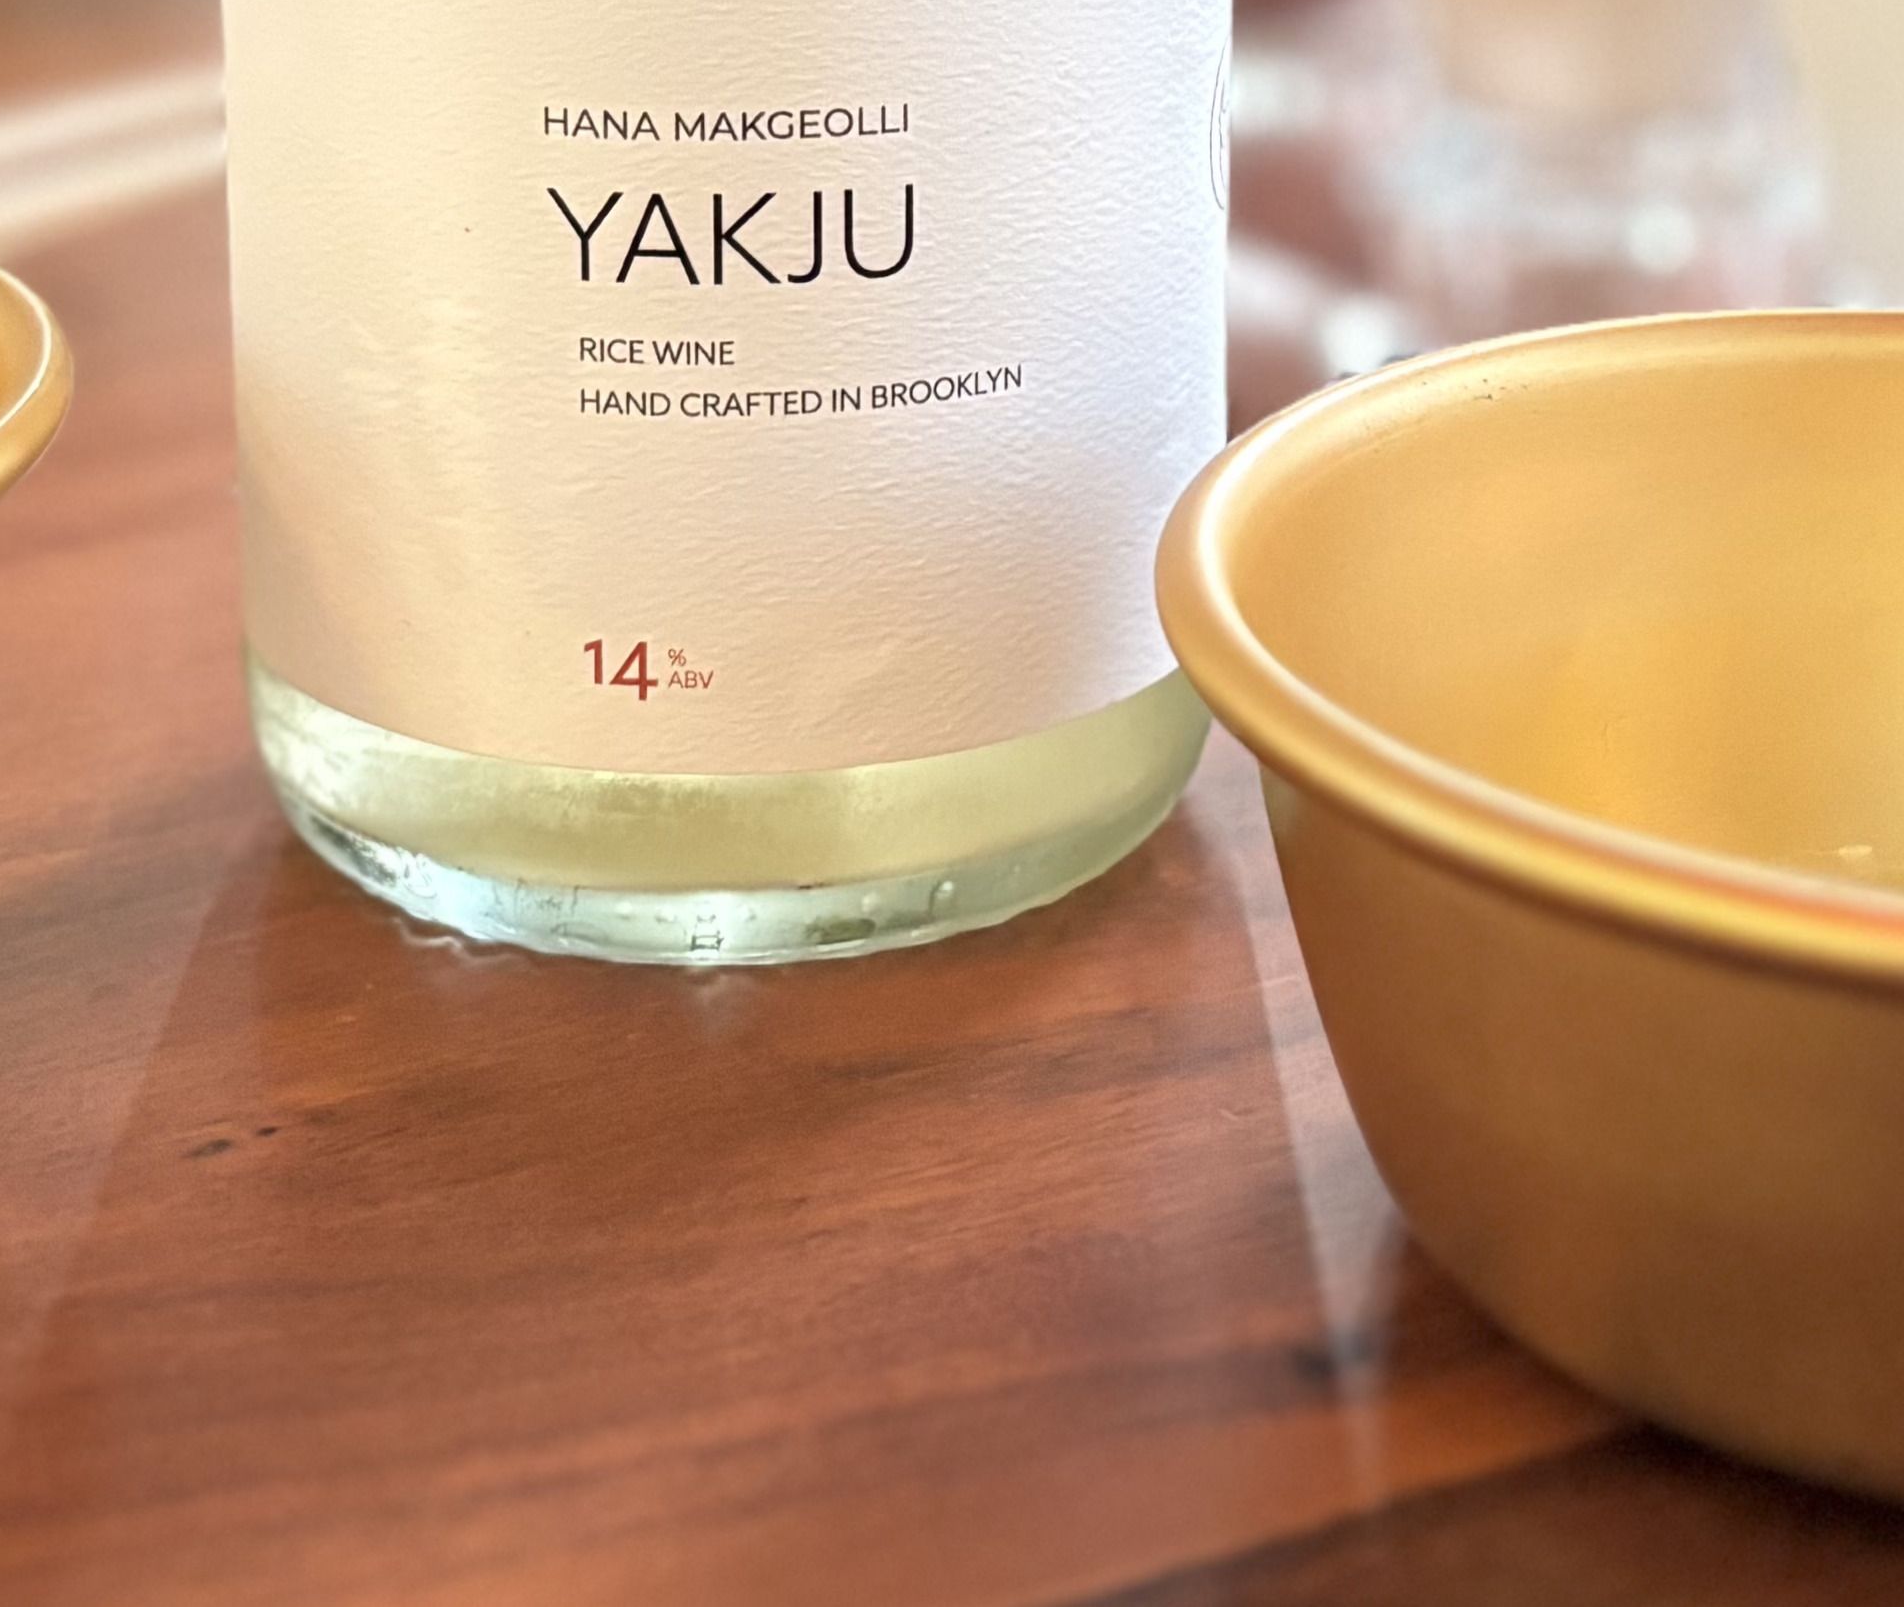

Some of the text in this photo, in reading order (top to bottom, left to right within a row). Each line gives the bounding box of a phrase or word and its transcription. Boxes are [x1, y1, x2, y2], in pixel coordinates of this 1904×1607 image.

[542, 102, 909, 143] HANA MAKGEOLLI
[545, 182, 915, 287] YAKJU
[578, 336, 736, 367] RICE WINE
[579, 363, 1023, 419] HAND CRAFTED IN BROOKLYN
[582, 638, 660, 703] 14
[666, 669, 715, 690] ABV
